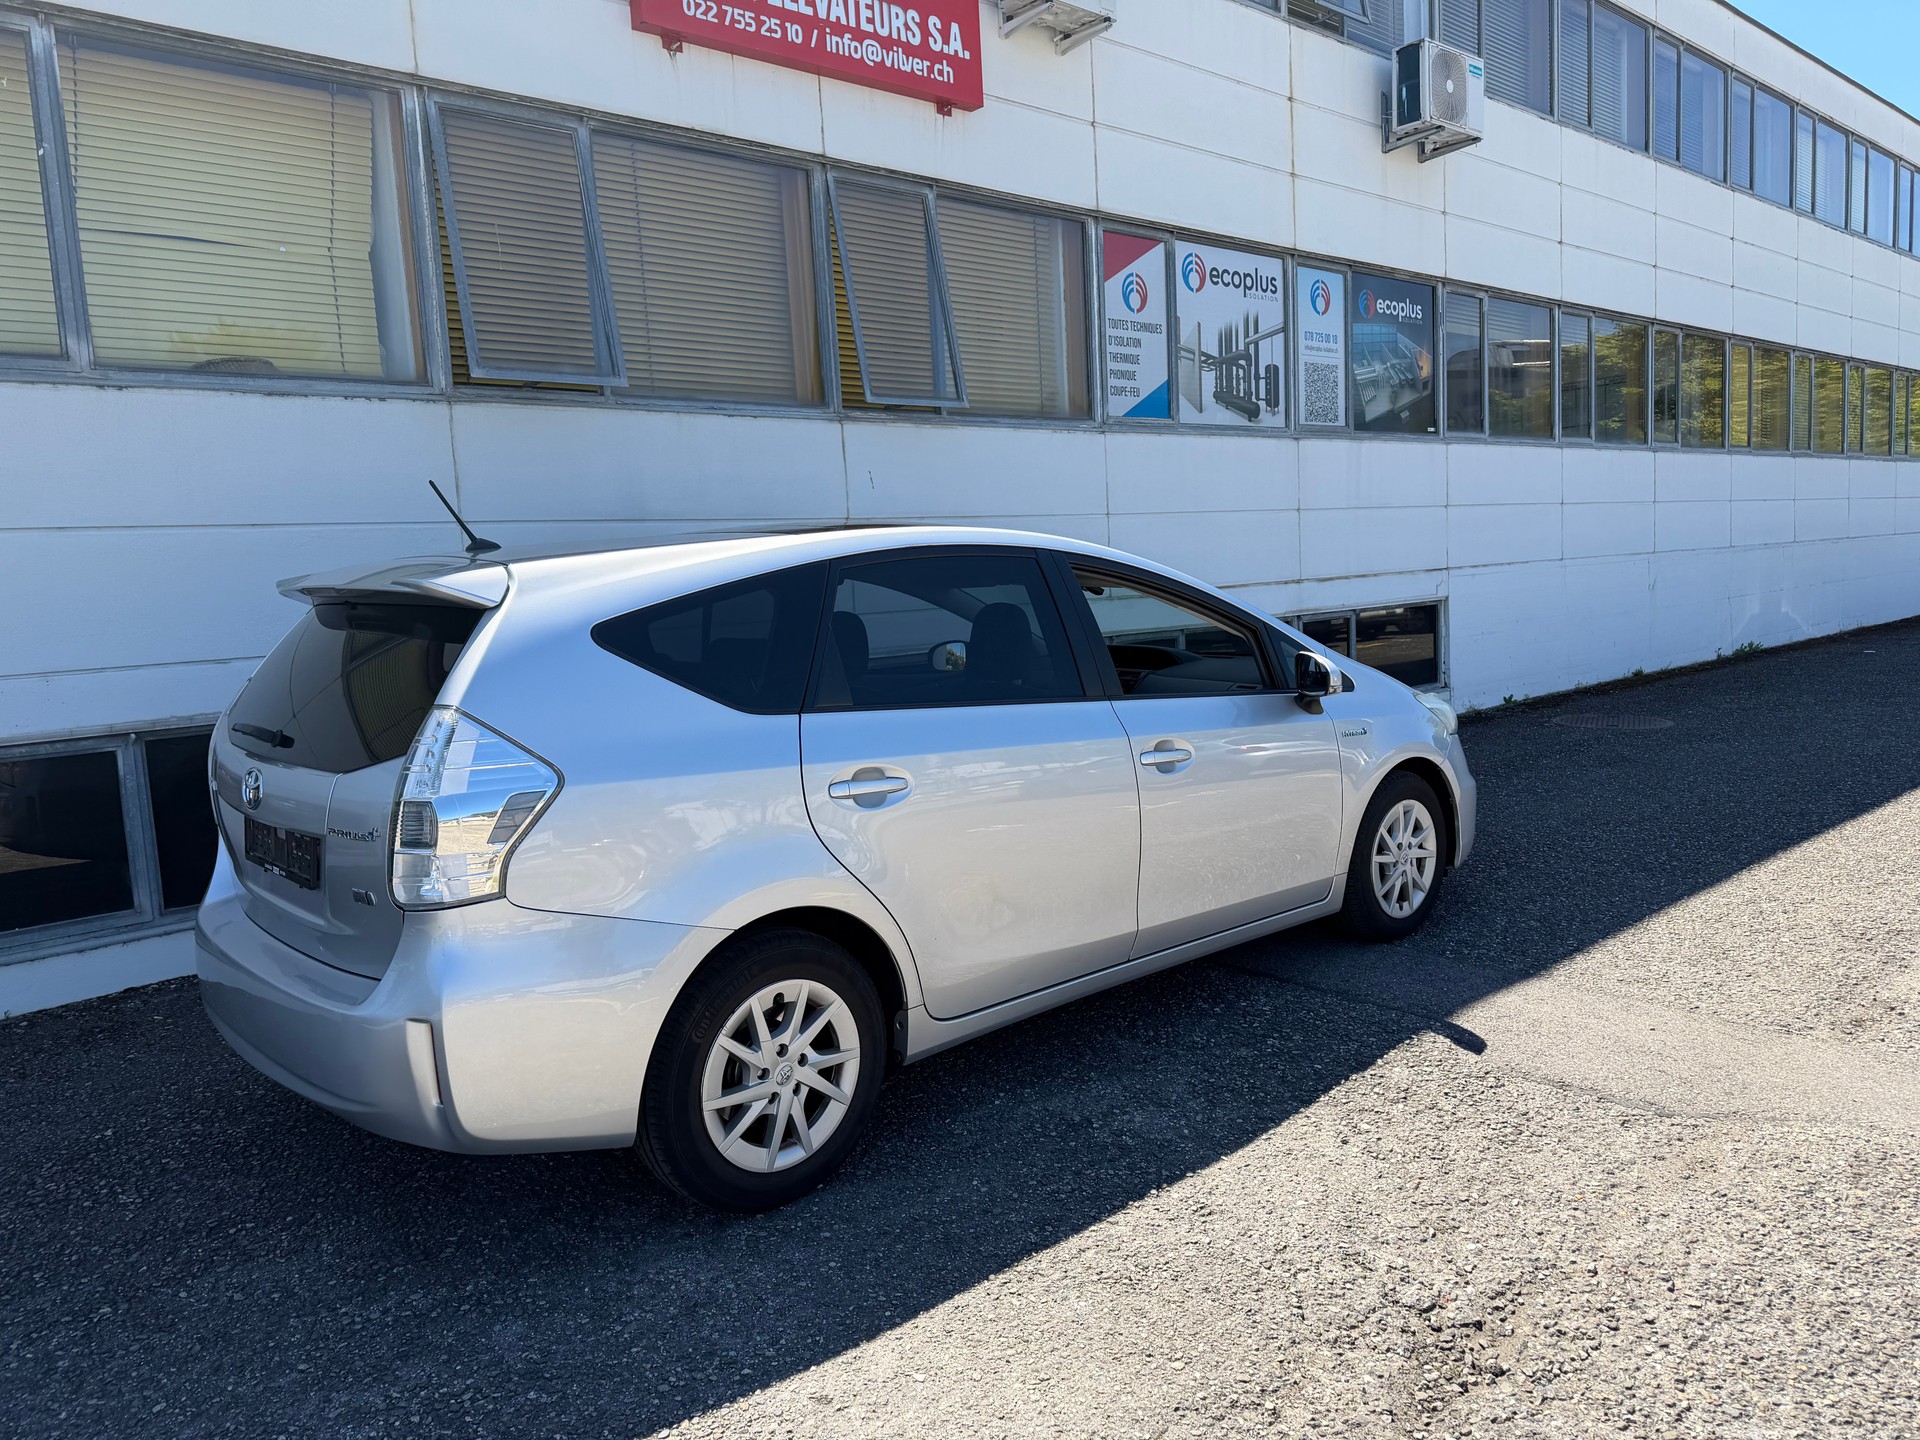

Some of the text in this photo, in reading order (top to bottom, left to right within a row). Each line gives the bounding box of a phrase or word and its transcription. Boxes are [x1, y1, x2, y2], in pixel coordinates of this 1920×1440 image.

[767, 0, 971, 60] VATEURS S.A.
[682, 0, 954, 84] 022 755 25 10 / info@vilver.ch
[1209, 267, 1278, 298] ecoplus
[1247, 293, 1279, 302] ISOLATION
[1376, 298, 1422, 322] ecoplus
[1108, 317, 1163, 335] TOUTES TECHNIQUES
[1108, 335, 1142, 348] D'ISOLATION
[1315, 332, 1324, 342] 725
[1109, 352, 1140, 365] THERMIQUE
[1109, 368, 1137, 381] PHONIQUE
[1110, 385, 1140, 398] COUPE-FEU
